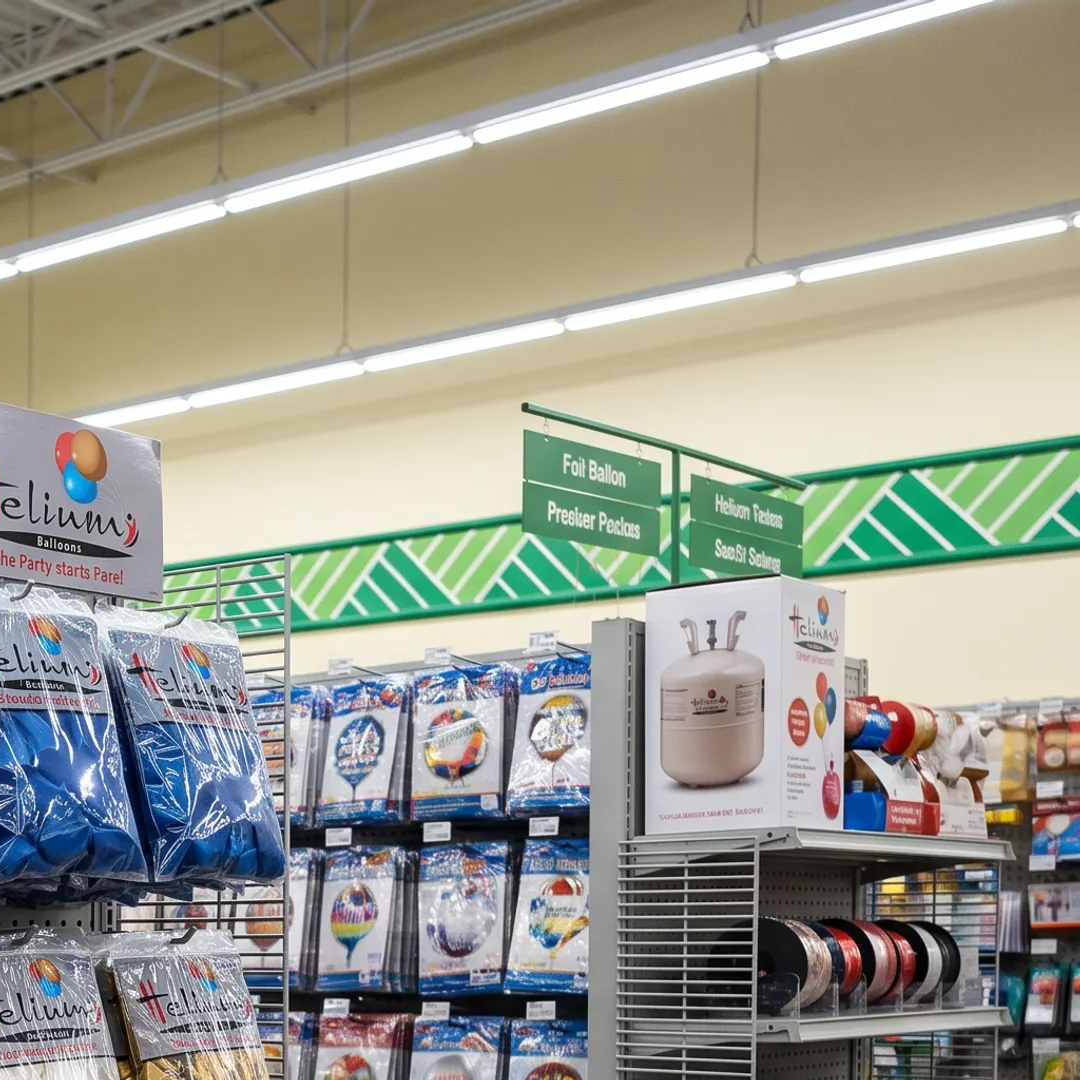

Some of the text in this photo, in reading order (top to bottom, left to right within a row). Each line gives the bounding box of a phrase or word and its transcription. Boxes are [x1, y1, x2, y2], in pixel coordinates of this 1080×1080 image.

[589, 459, 626, 488] Ballon
[37, 536, 82, 553] Balloons
[20, 553, 53, 577] Party
[56, 563, 90, 579] starts
[94, 567, 124, 585] Pare!
